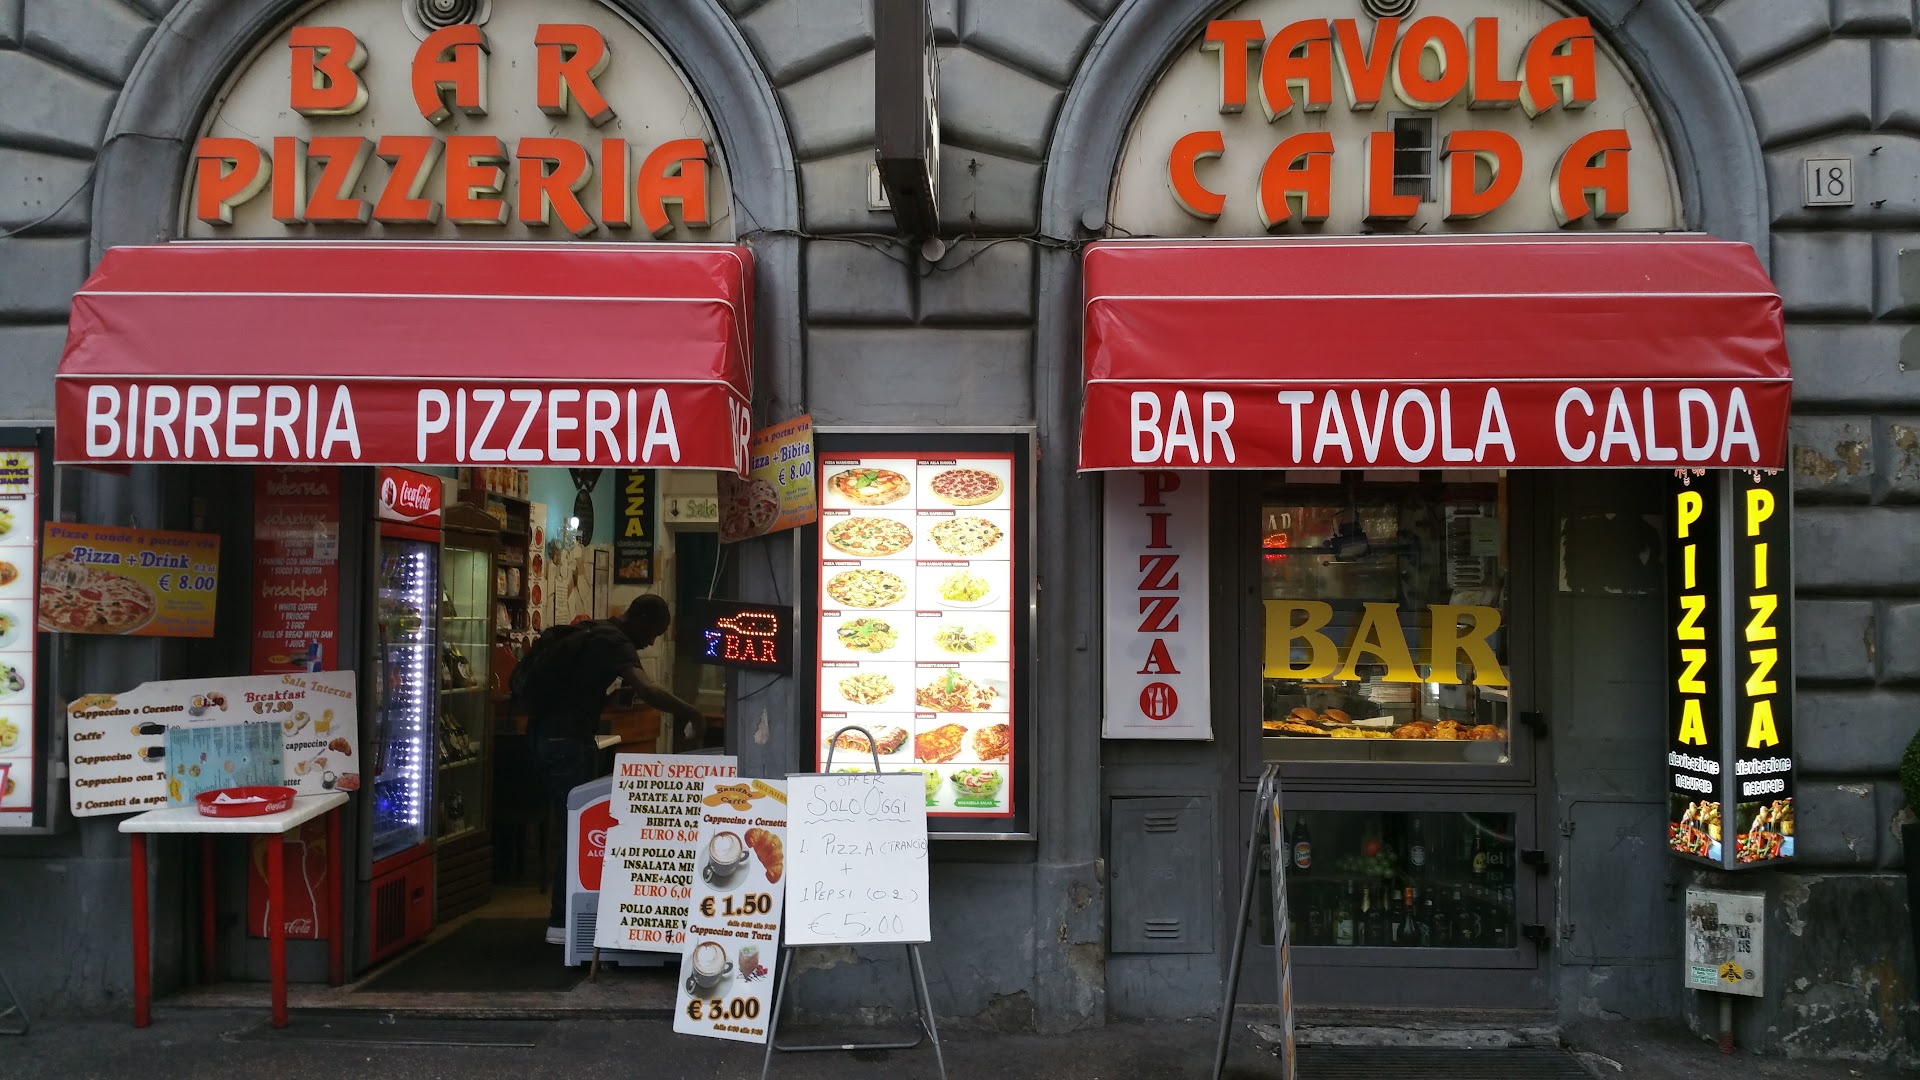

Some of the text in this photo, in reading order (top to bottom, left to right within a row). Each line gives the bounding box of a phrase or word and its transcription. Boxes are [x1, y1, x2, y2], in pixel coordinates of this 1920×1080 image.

[288, 23, 616, 127] BAR
[1202, 16, 1597, 122] TAVOLA
[197, 136, 711, 239] PIZZERIA
[1167, 129, 1632, 231] CALDA
[1816, 167, 1844, 197] 18
[86, 384, 681, 464] BIRRERIA PIZZERIA
[771, 427, 795, 442] portar
[797, 422, 809, 432] via
[1130, 386, 1760, 464] BAR TAVOLA CALDA
[728, 396, 750, 476] BAR
[751, 453, 770, 470] izza
[780, 442, 810, 463] Bibita
[778, 460, 811, 486] € 8.00
[624, 470, 646, 537] ZZA
[72, 547, 190, 568] Pizza + Drink
[1137, 470, 1181, 675] PIZZA
[158, 574, 215, 592] € 8.00
[262, 578, 329, 601] breakfast
[1676, 490, 1708, 746] PIZZA
[1745, 488, 1779, 750] PIZZA
[725, 634, 777, 663] BAR
[1263, 599, 1510, 686] BAR
[281, 674, 353, 700] Sala Interna
[244, 690, 306, 703] Breakfast
[73, 707, 131, 720] Cappuccino
[142, 704, 184, 714] Cornetto
[264, 700, 294, 714] 7.90
[285, 738, 328, 752] cappuccino
[74, 752, 132, 765] Cappuccino
[620, 760, 665, 778] MENÙ
[75, 774, 153, 788] Cappuccino con
[618, 779, 634, 791] 1/4
[636, 780, 648, 790] DI
[650, 780, 683, 791] POLLO
[76, 797, 140, 810] 3 Cornetti da
[628, 792, 702, 804] PATATE AL FO
[630, 804, 683, 815] INSALATA
[646, 817, 682, 828] BIBITA
[703, 814, 747, 825] Cappuccino
[755, 817, 787, 828] Cornetto
[640, 828, 675, 840] EURO
[611, 847, 626, 859] 1/4
[629, 847, 640, 857] DI
[642, 848, 675, 859] POLLO
[623, 859, 677, 871] INSALATA
[840, 862, 853, 876] +
[633, 884, 667, 898] EURO
[620, 903, 652, 914] POLLO
[700, 892, 773, 918] € 1.50
[620, 917, 629, 926] A
[631, 917, 679, 929] PORTARE
[628, 928, 662, 942] EURO
[690, 925, 733, 936] Cappuccino
[751, 931, 772, 941] Torta
[686, 996, 760, 1021] € 3.00
